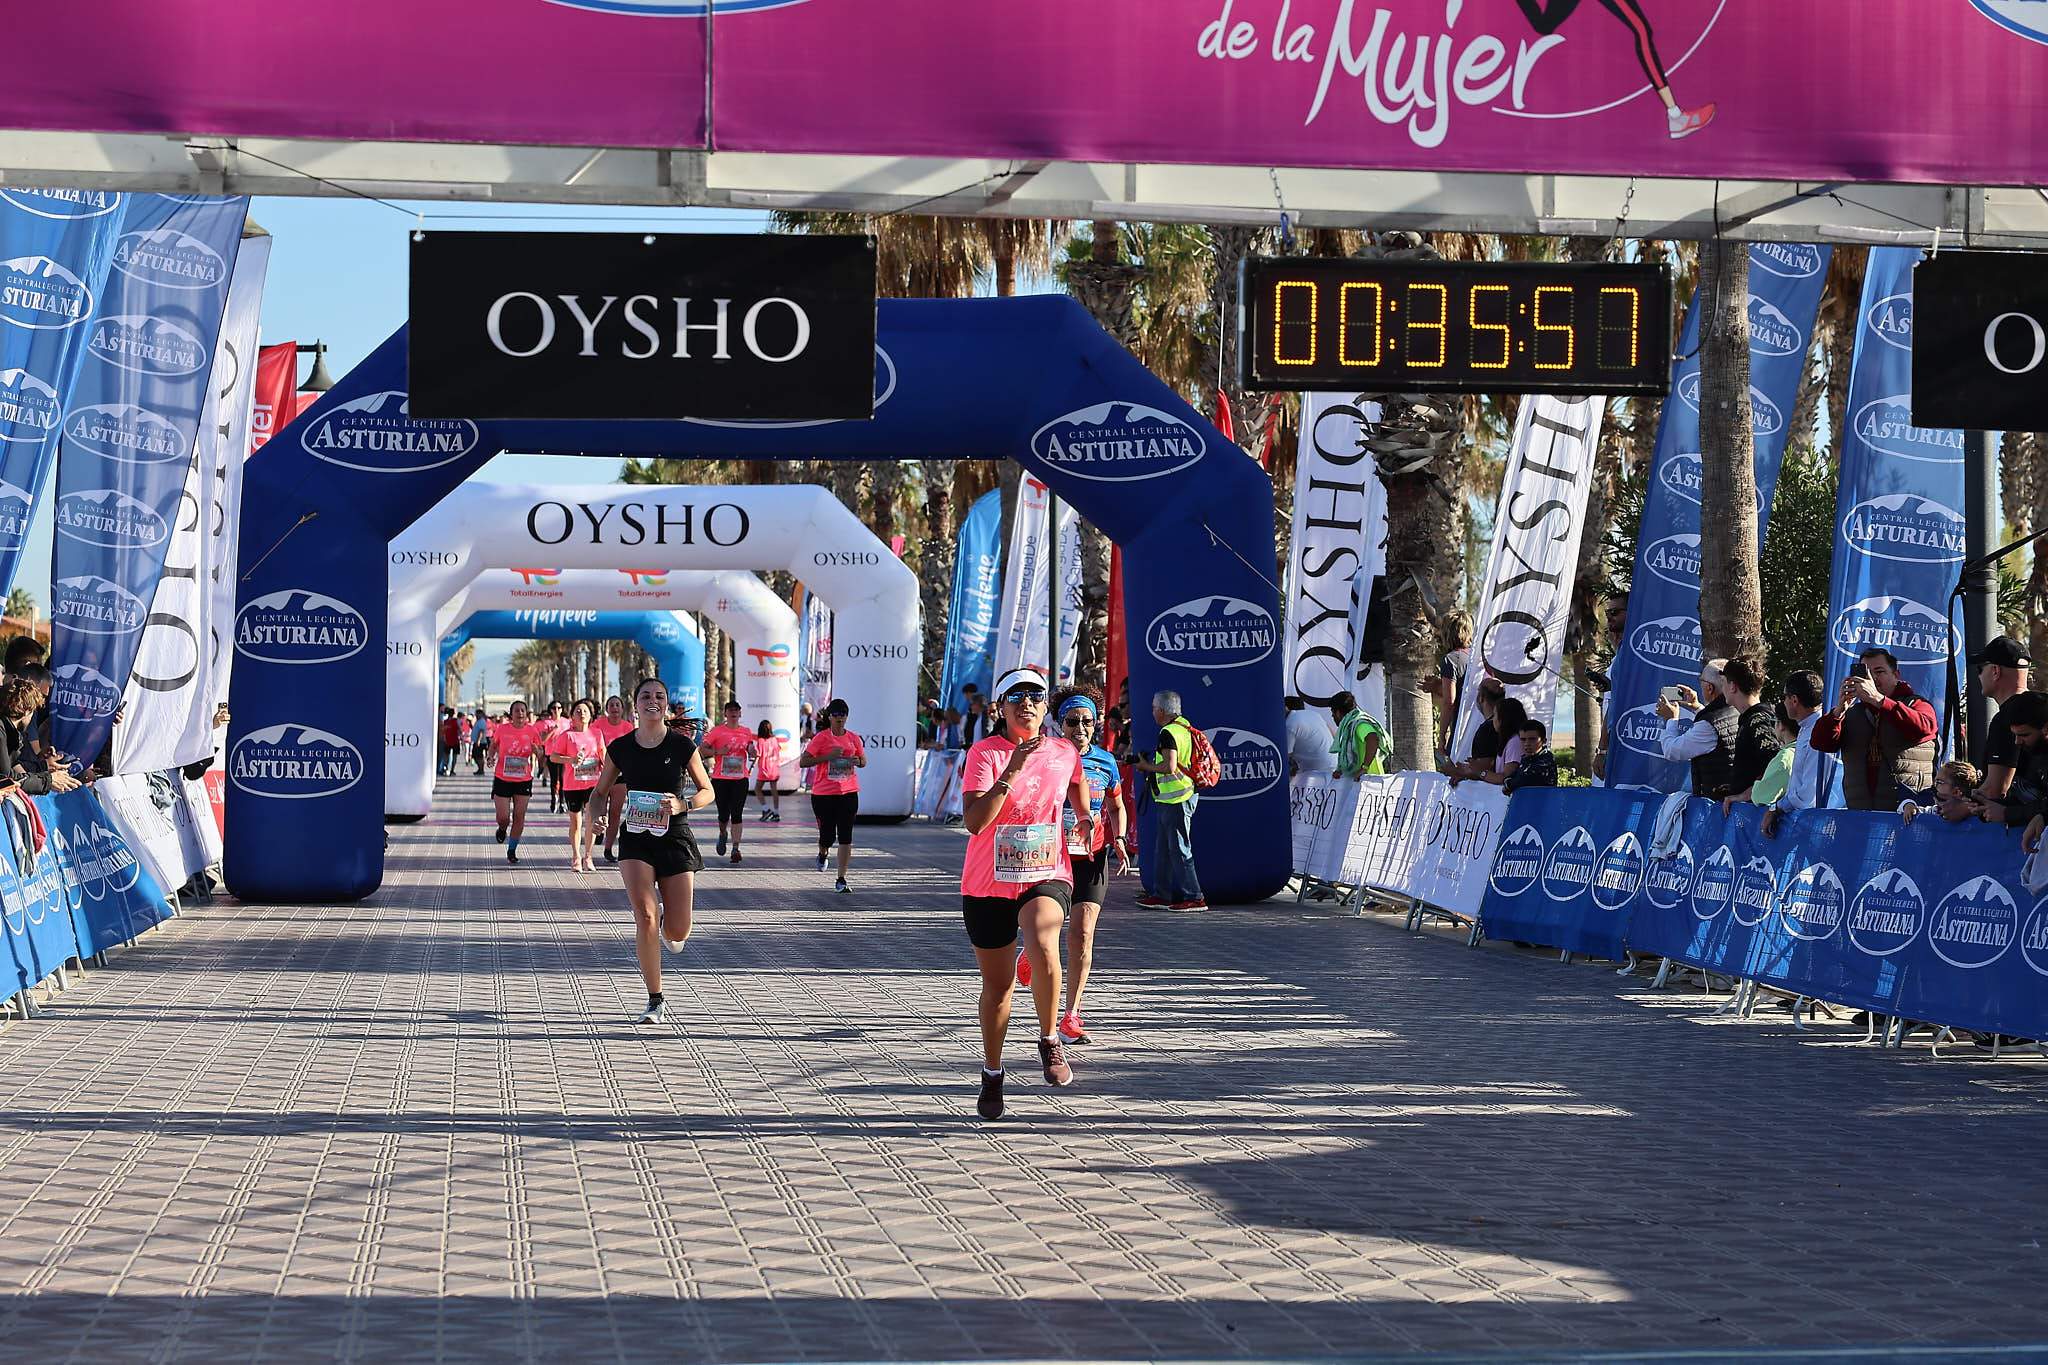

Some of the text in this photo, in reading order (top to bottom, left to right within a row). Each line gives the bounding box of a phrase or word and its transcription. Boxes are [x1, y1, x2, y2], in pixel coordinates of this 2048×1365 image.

[1198, 0, 1566, 148] de la Mujer
[114, 240, 216, 282] ASTURIANA
[1, 287, 81, 318] STURIANA
[486, 291, 811, 362] OYSHO
[1274, 281, 1639, 370] 00:35:57
[1750, 324, 1792, 351] RIANA
[90, 326, 196, 368] ASTURIANA
[71, 416, 175, 455] ASTURIANA
[311, 421, 465, 452] ASTURIANA
[341, 417, 463, 430] CENTRAL LECHERA
[1069, 426, 1187, 439] CENTRAL LECHERA
[1045, 433, 1197, 462] ASTURIANA
[58, 503, 156, 541] ASTURIANA
[527, 501, 750, 546] OYSHO
[1850, 513, 1967, 553] ASTURIANA
[1481, 396, 1593, 685] OYSH
[391, 551, 459, 566] OYSHO
[813, 551, 880, 566] OYSHO
[510, 590, 563, 598] TotalEnergies
[56, 600, 137, 626] STURIANA
[256, 614, 302, 623] CENTRAL
[1174, 619, 1225, 629] CENTRAL
[238, 616, 359, 647] ASTURIANA
[1155, 624, 1272, 652] ASTURIANA
[1839, 617, 1949, 655] ASTURIANA
[385, 641, 422, 656] SHO
[847, 644, 909, 659] OYSHO
[250, 748, 351, 759] CENTRAL LECHERA
[860, 734, 906, 749] YSHO
[234, 750, 354, 780] ASTURIANA
[1220, 759, 1278, 781] RIANA
[1357, 793, 1417, 841] OYSHO
[1427, 800, 1490, 860] OYSHO
[1494, 851, 1538, 878] ASTURIANA
[1544, 851, 1590, 884] ASTURIANA
[1593, 857, 1638, 893] ASTURIANA
[1850, 897, 1915, 935] ASTURIANA
[1933, 906, 2009, 946] ASTURIANA
